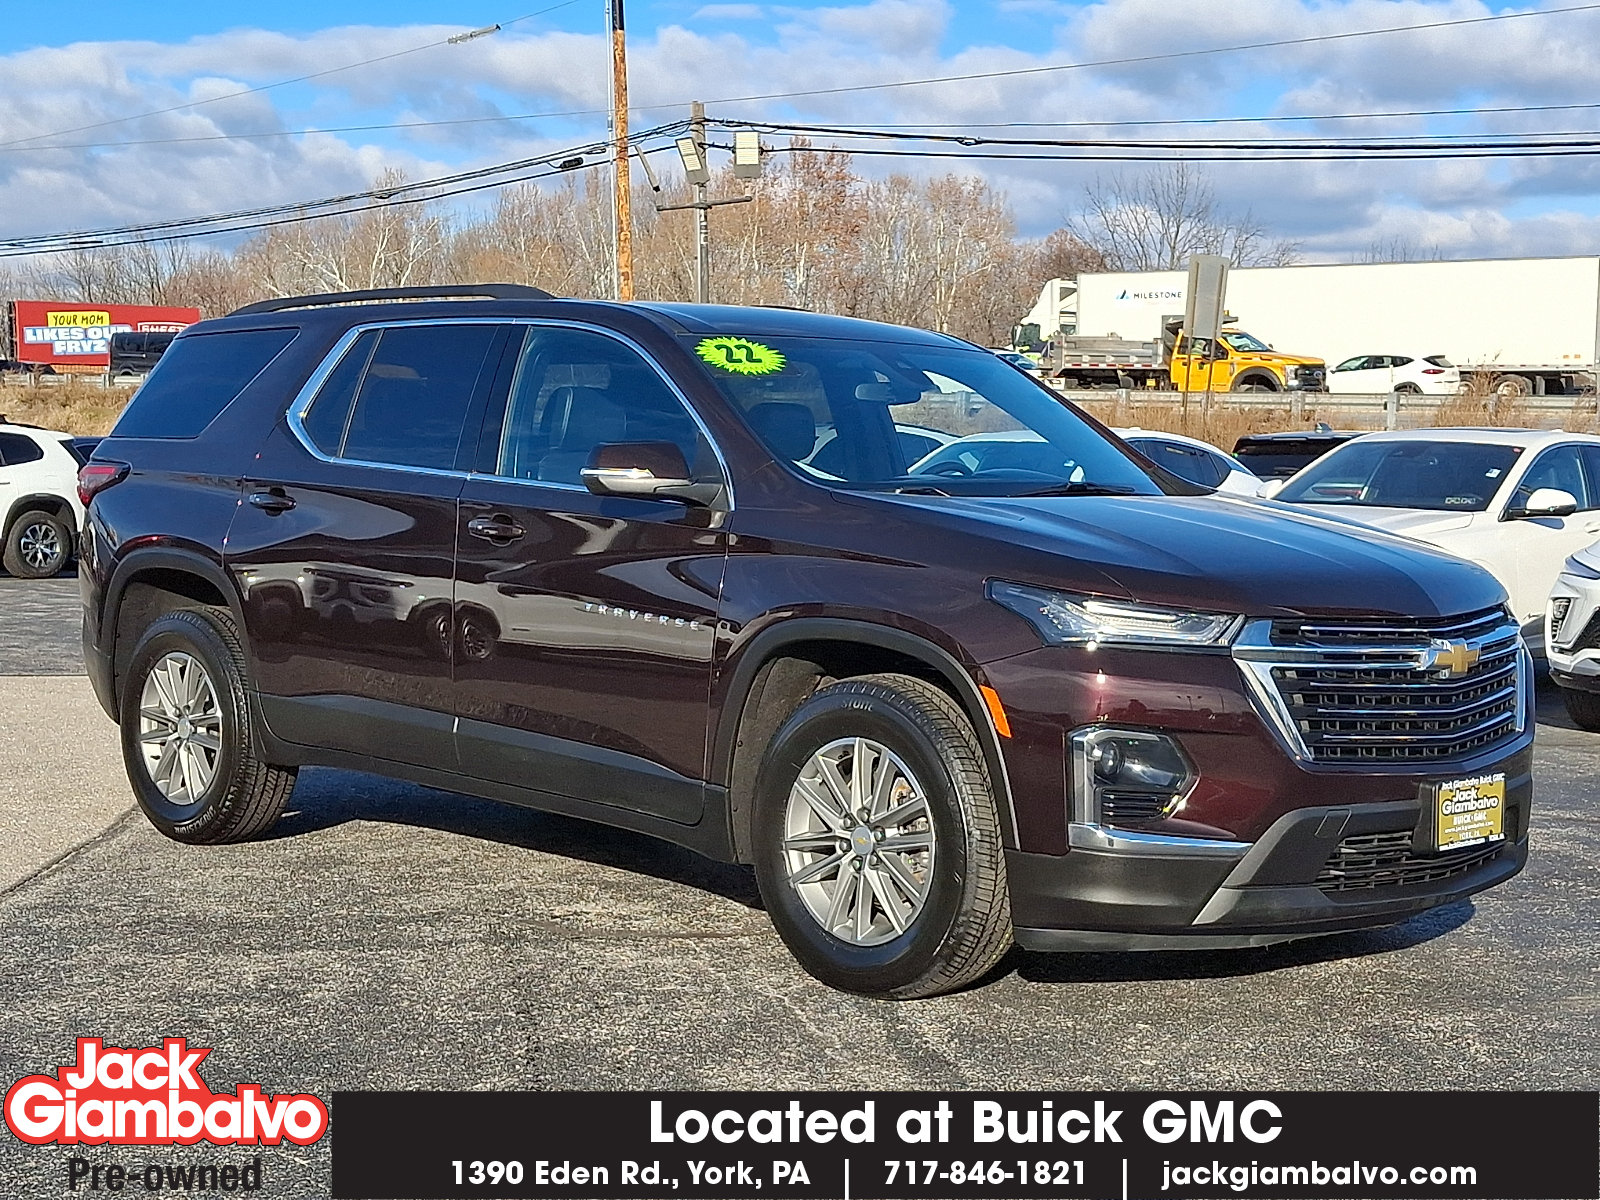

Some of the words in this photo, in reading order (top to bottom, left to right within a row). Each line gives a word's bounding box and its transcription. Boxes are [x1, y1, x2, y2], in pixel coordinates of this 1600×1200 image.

[53, 314, 78, 326] YOUR
[81, 314, 104, 325] MOM
[25, 327, 84, 341] LIKES
[54, 340, 107, 353] FRYZ
[714, 344, 763, 364] 22
[584, 602, 700, 631] TRAVERSE
[1452, 787, 1478, 802] Jack
[1442, 796, 1499, 815] Giambalvo
